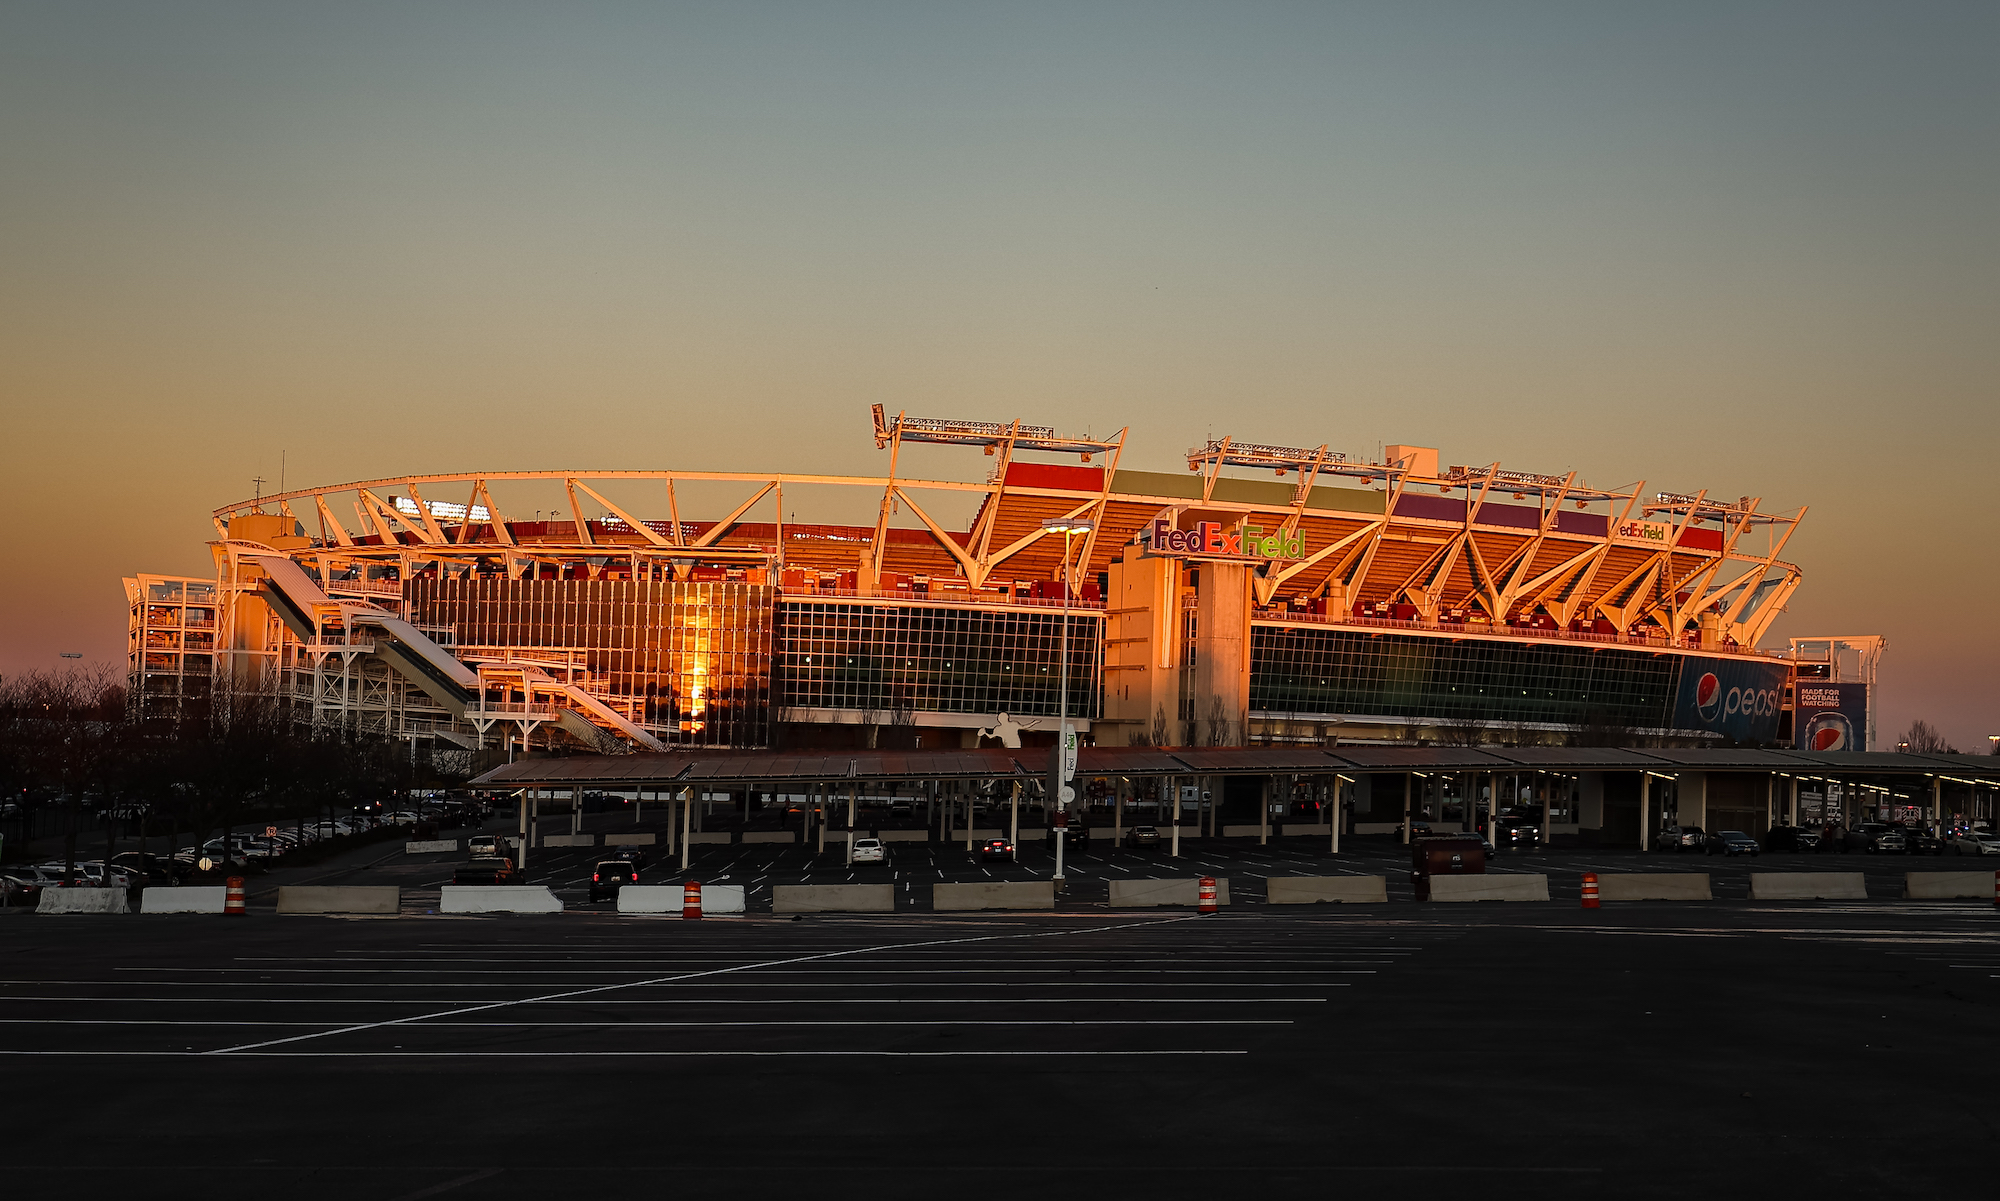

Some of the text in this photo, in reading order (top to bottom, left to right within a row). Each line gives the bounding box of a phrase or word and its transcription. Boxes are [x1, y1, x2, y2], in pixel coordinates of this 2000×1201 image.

[1153, 518, 1306, 559] FedExField
[1617, 523, 1664, 540] edExField
[1722, 683, 1781, 724] pepsi
